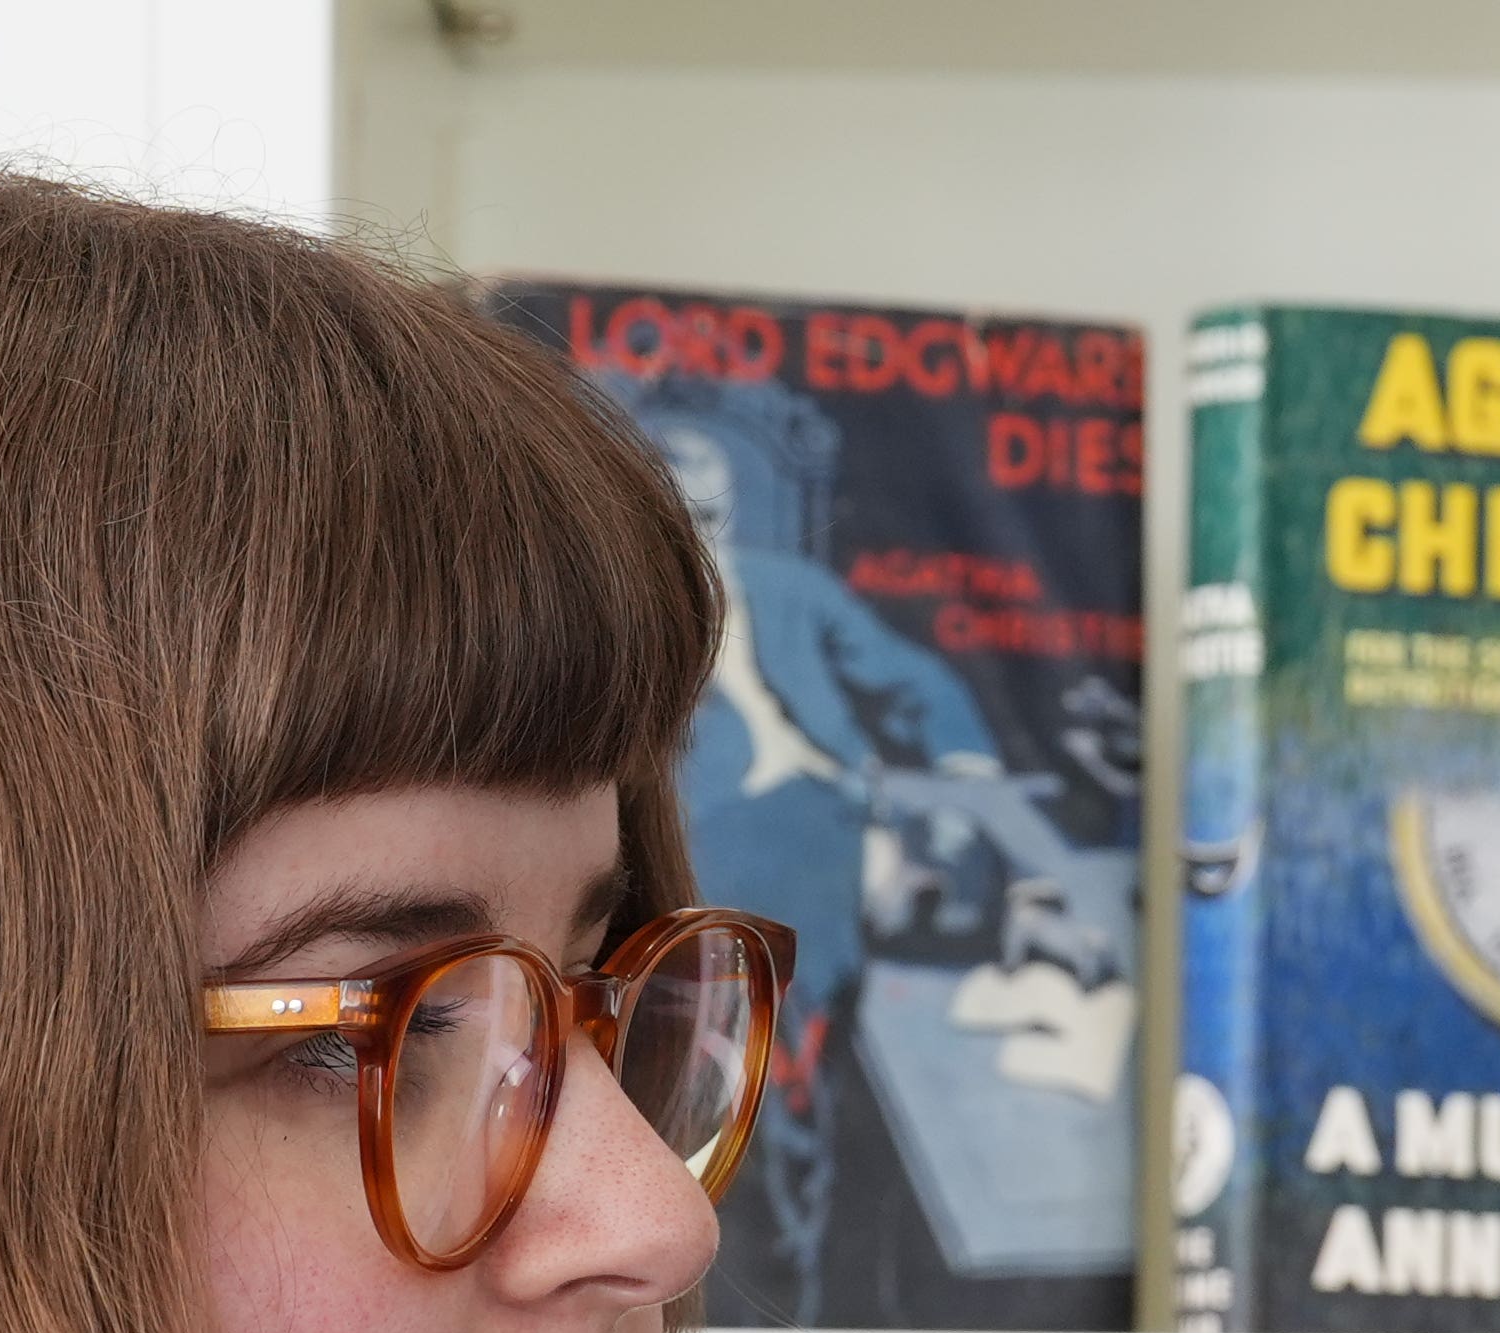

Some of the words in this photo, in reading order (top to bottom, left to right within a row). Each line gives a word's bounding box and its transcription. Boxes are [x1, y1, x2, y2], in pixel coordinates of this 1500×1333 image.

[570, 298, 784, 381] LORD
[847, 549, 1041, 600] AGATHA
[1304, 1085, 1382, 1176] A
